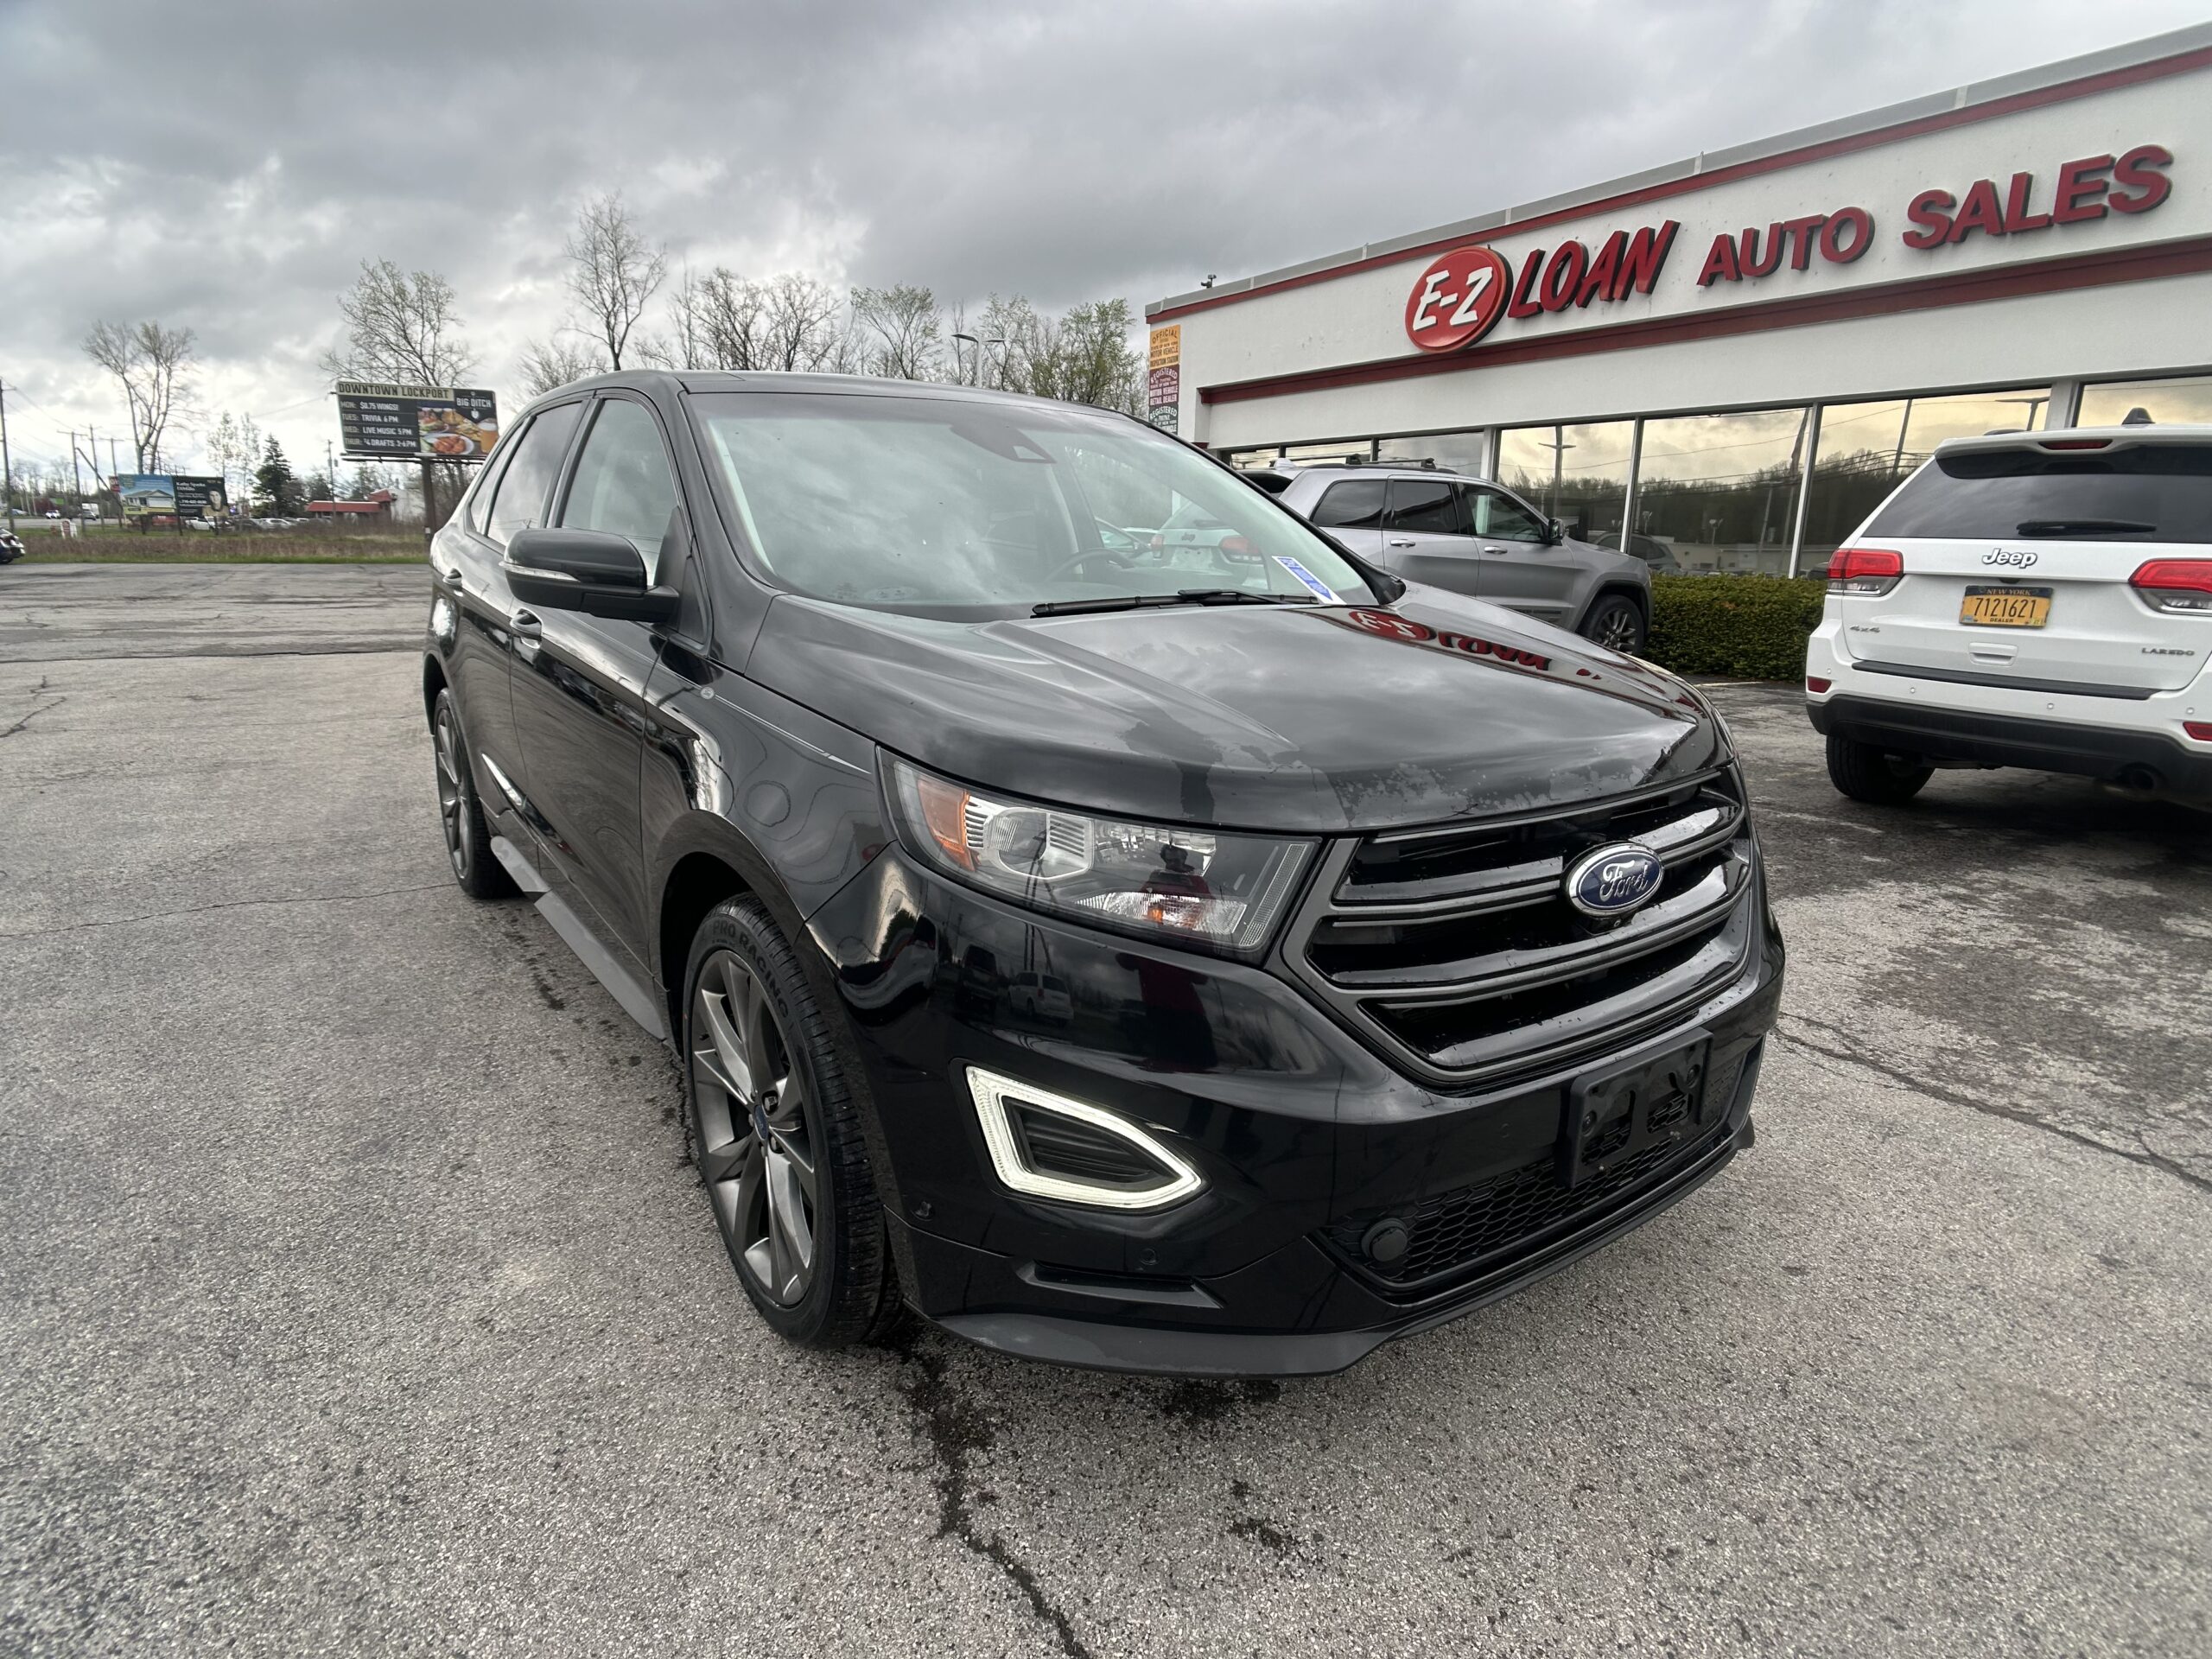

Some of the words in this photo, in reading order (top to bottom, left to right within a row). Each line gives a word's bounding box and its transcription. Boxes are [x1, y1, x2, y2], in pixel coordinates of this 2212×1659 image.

[1413, 266, 1493, 331] E-Z
[1508, 219, 1681, 319] LOAN
[1696, 207, 1875, 286] AUTO
[1903, 145, 2174, 249] SALES
[1152, 329, 1178, 344] OFFICIAL
[1150, 367, 1178, 385] REGISTERED
[338, 382, 398, 397] DOWNTOWN
[402, 386, 449, 399] LOCKPORT
[456, 397, 469, 407] BIG
[470, 397, 492, 409] DITCH
[361, 414, 382, 423] TRIVIA
[1150, 405, 1178, 421] REGISTERED
[362, 426, 377, 435] LIVE
[377, 427, 397, 435] MUSIC
[1981, 547, 2038, 569] Jeep
[1974, 597, 2037, 619] 7121621
[2141, 647, 2196, 657] LAREDO
[1599, 859, 1649, 902] Ford
